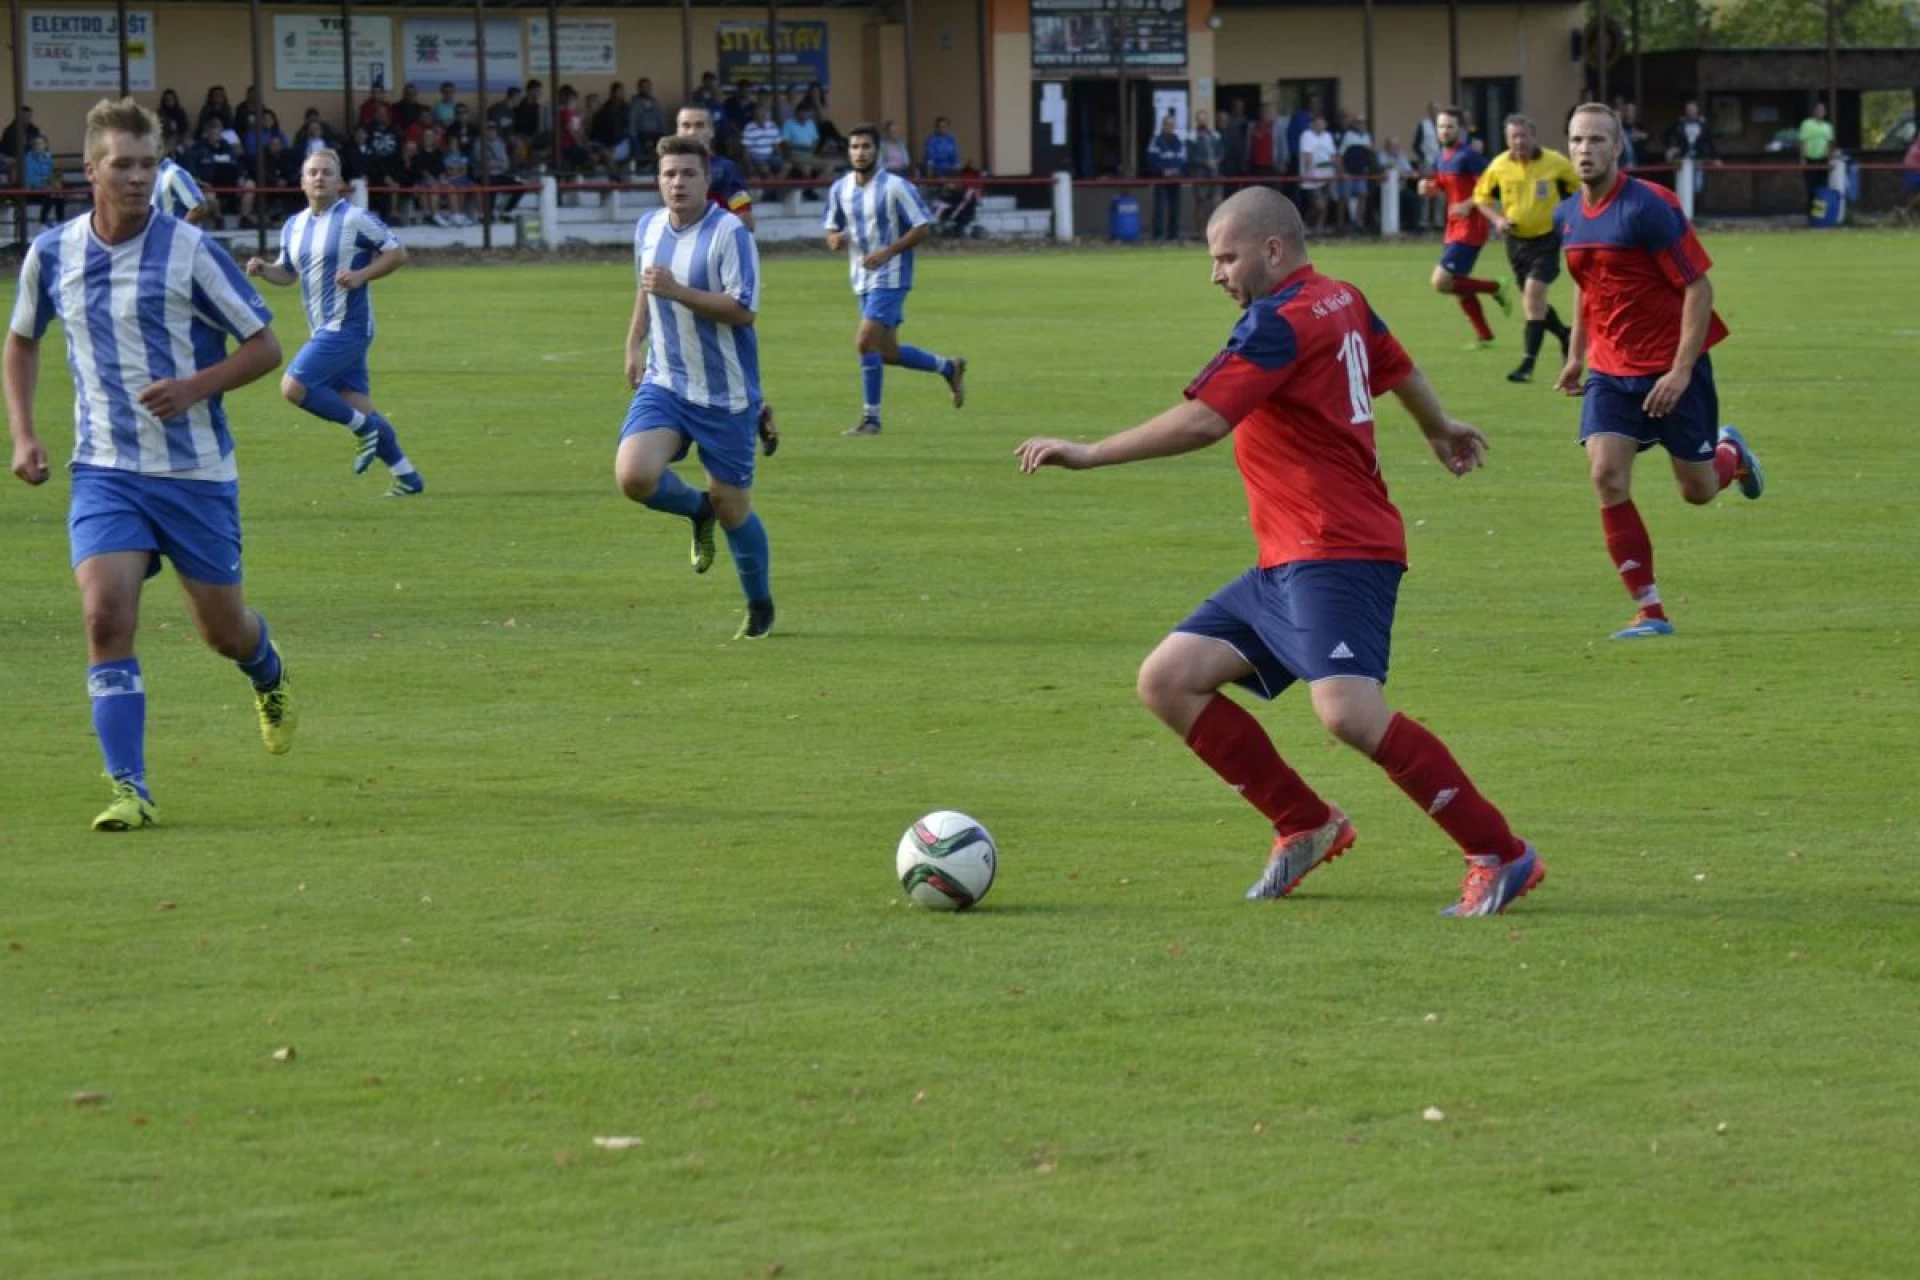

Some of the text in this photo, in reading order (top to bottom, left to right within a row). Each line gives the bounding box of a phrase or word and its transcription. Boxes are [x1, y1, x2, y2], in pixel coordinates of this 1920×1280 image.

[32, 14, 147, 33] ELEKTRO JŠT
[1336, 330, 1374, 424] 10
